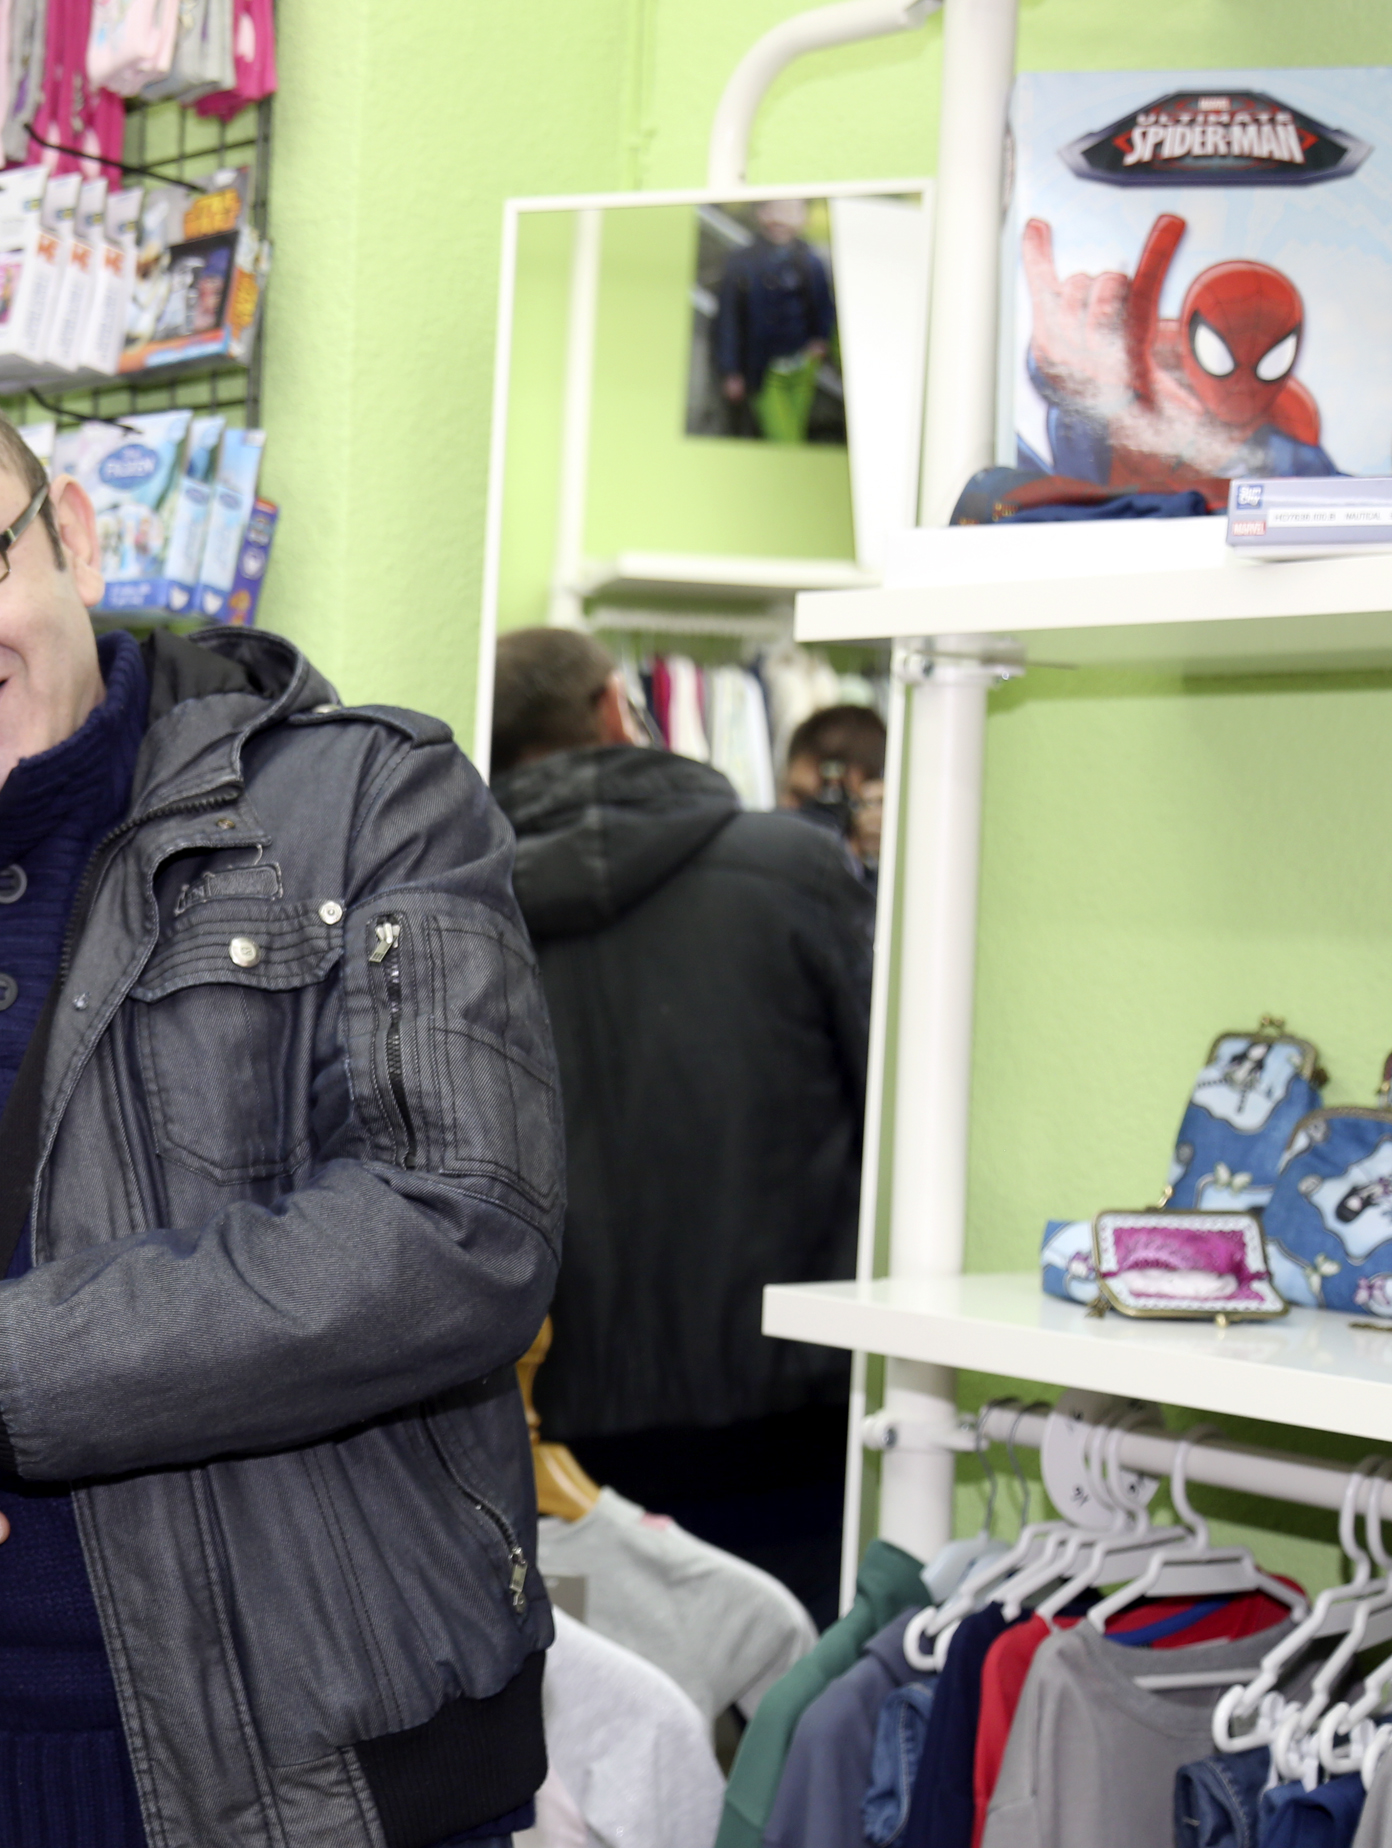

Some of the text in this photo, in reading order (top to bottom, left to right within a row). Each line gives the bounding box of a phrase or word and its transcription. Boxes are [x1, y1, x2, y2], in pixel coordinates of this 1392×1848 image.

[1136, 111, 1295, 127] ULTIMATE
[1122, 123, 1306, 167] SPIDER-MAN
[1233, 522, 1266, 536] MARVEL
